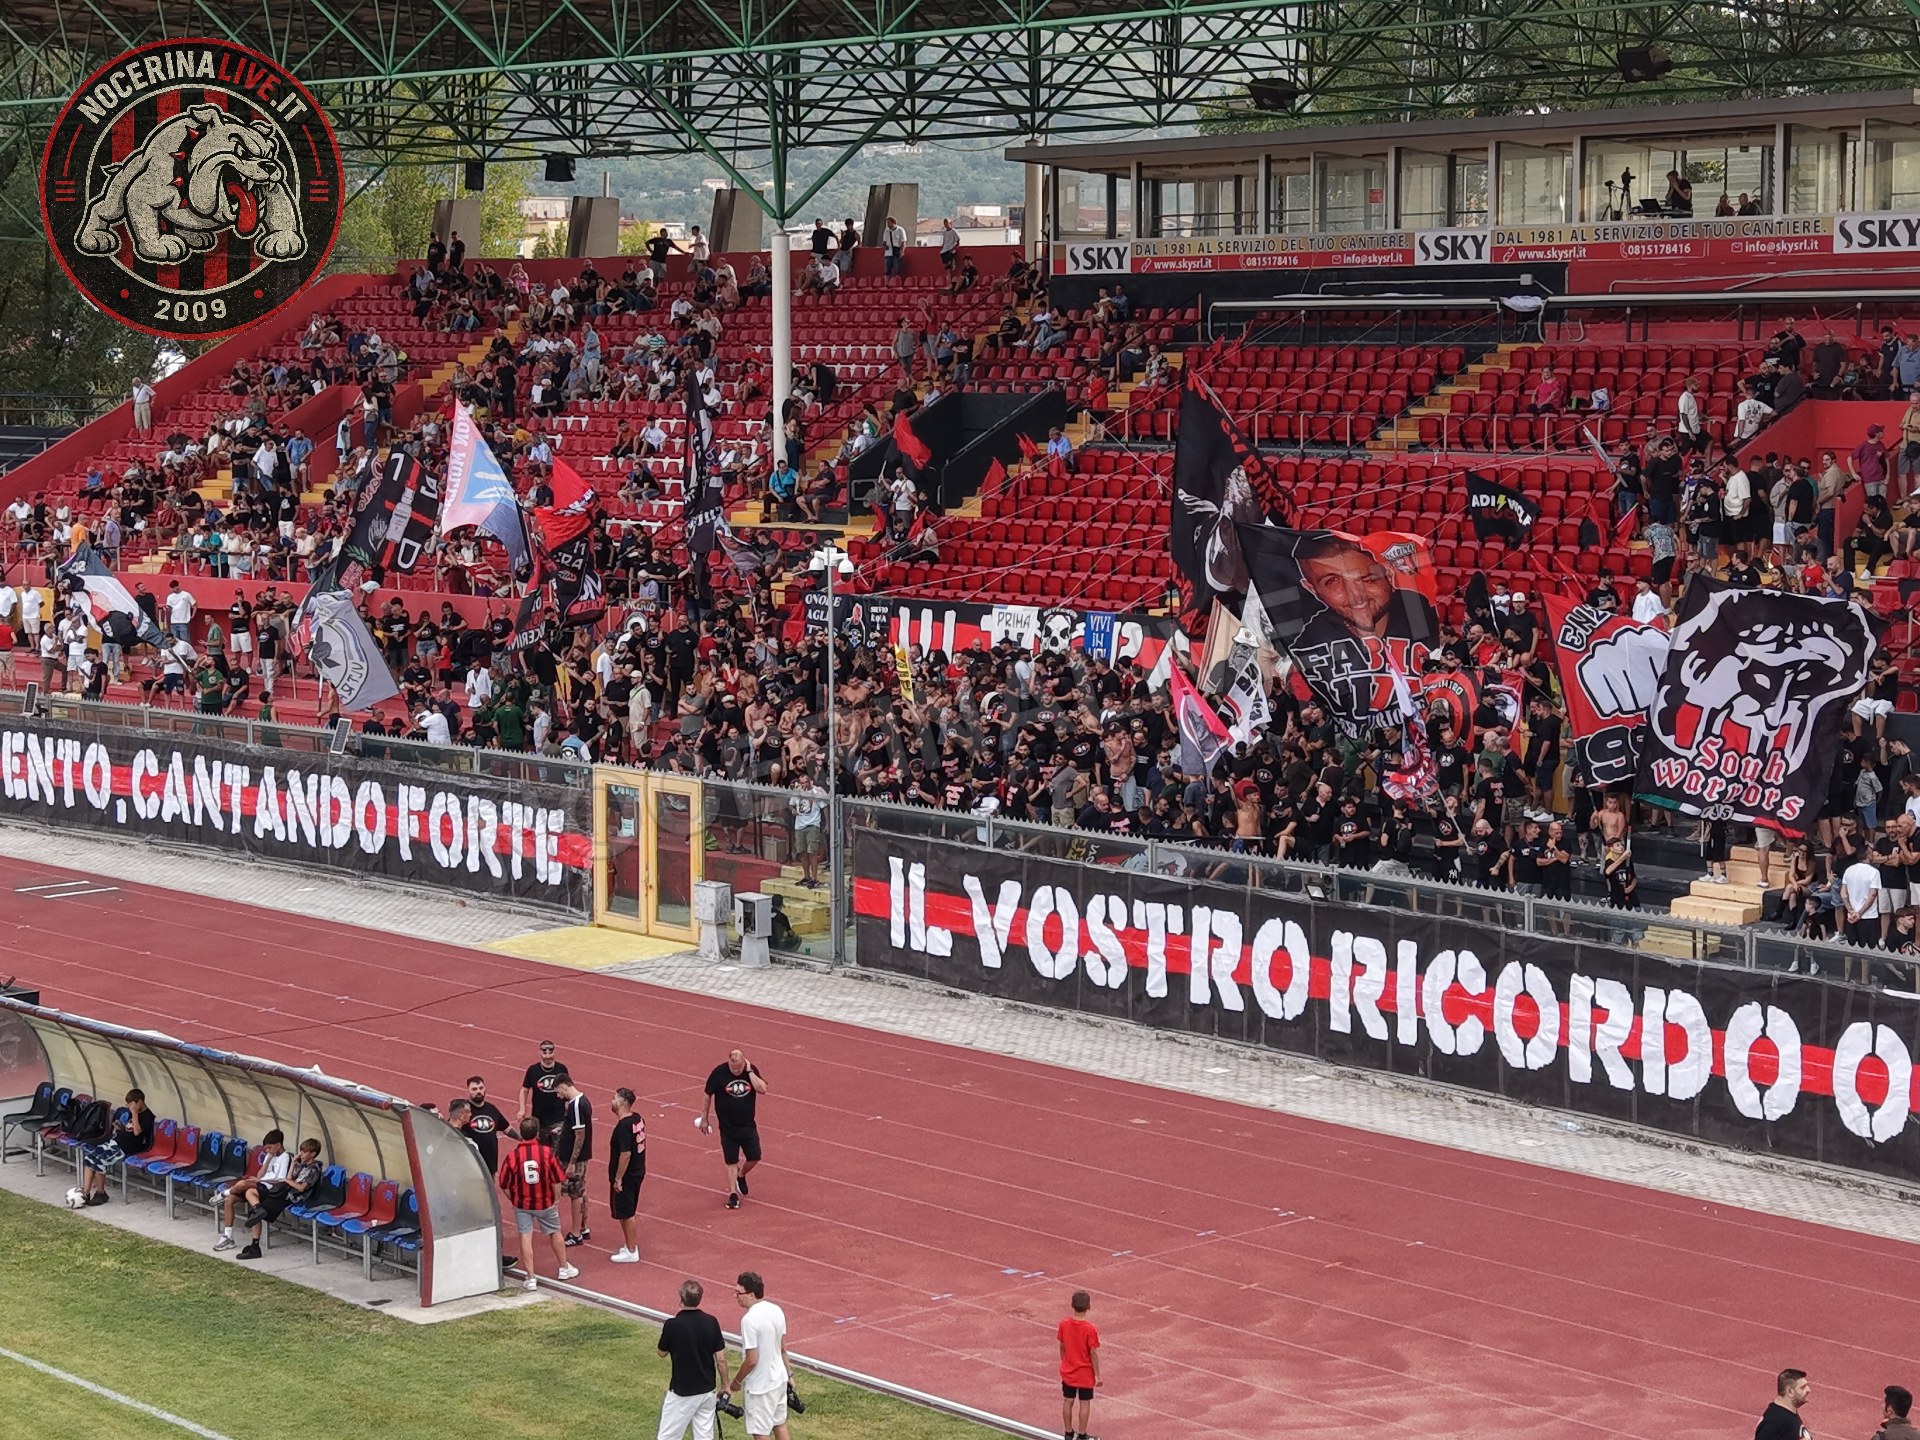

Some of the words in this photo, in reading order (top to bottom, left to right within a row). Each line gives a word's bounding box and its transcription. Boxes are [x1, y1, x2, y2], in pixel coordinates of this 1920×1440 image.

[1496, 232, 1523, 244] DAL
[1530, 231, 1562, 243] 1981
[1570, 229, 1587, 241] AL
[1594, 226, 1663, 241] SERVIZIO
[1670, 225, 1698, 238] DEL
[1703, 223, 1735, 237] TUO
[1136, 244, 1158, 256] DAL
[1164, 243, 1191, 255] 1981
[1198, 242, 1213, 254] AL
[1217, 239, 1276, 253] SERVIZIO
[1281, 239, 1304, 251] DEL
[1309, 237, 1335, 250] TUO
[1434, 235, 1487, 261] SKY
[1518, 246, 1587, 261] www.skysrl.it
[1627, 243, 1691, 256] 0815178416
[1745, 239, 1819, 253] info@skysrl.it
[1082, 246, 1128, 271] SKY
[1154, 258, 1213, 272] www.skysrl.it
[1246, 256, 1299, 267] 0815178416
[1343, 252, 1403, 266] info@skysrl.it
[1471, 494, 1496, 508] ADI
[997, 611, 1031, 629] PRIMA
[1090, 615, 1112, 632] VIVI
[132, 748, 386, 855] CANTANDO
[398, 783, 565, 886] FORTE
[889, 856, 952, 957] IL
[963, 875, 1310, 1021] VOSTRO
[1330, 930, 1801, 1122] RICORDO
[524, 1160, 540, 1185] 6
